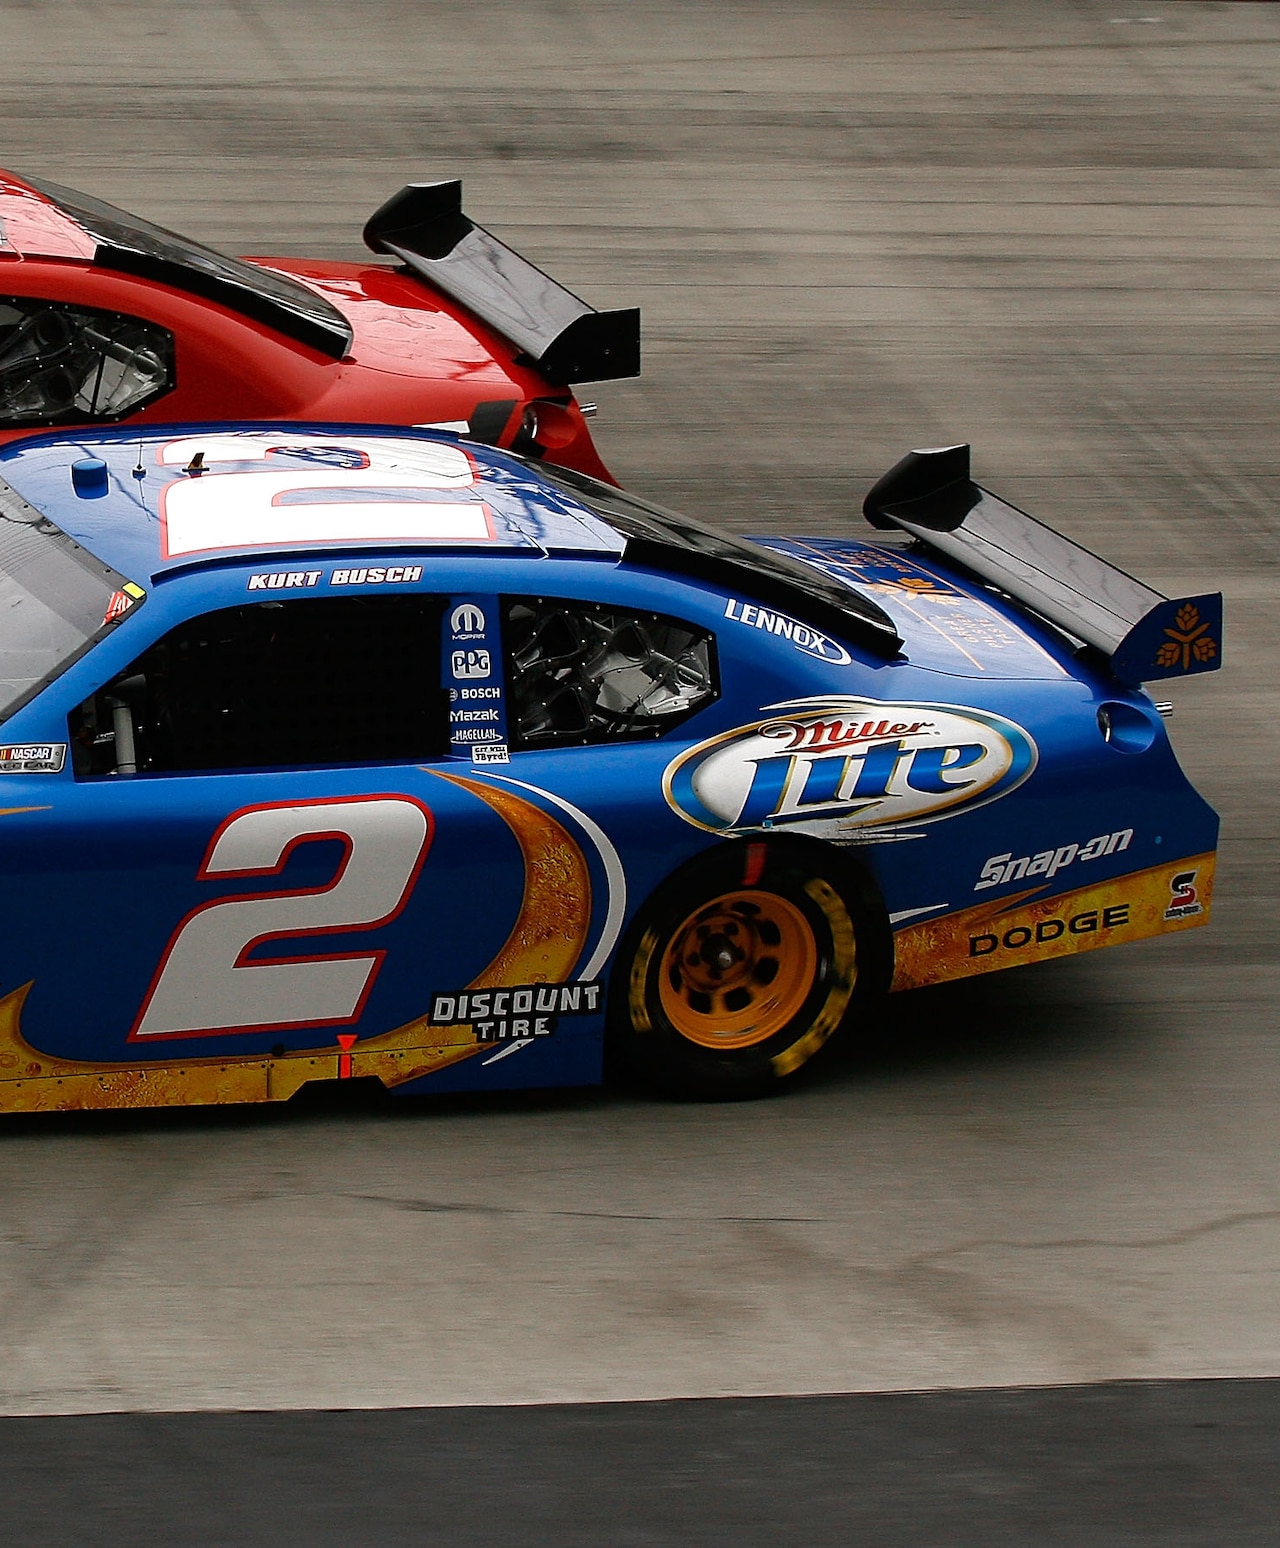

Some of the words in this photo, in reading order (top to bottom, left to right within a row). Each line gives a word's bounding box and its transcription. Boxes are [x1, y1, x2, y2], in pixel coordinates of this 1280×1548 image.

[157, 433, 498, 560] 2
[248, 571, 321, 590] KURT
[330, 566, 422, 585] BUSCH
[724, 598, 827, 655] LENNOX
[453, 650, 489, 676] PPG
[461, 688, 501, 699] BOSCH
[449, 709, 499, 722] Mazak
[455, 729, 496, 741] MAGELLAN
[758, 718, 936, 754] Miller
[11, 747, 50, 760] NASCAR
[475, 752, 507, 762] JByrd!
[720, 740, 988, 832] Lite
[973, 828, 1134, 891] Snap-on
[126, 792, 435, 1043] 2
[969, 903, 1130, 958] DODGE
[433, 985, 600, 1021] DISCOUNT
[477, 1017, 550, 1039] TIRE
